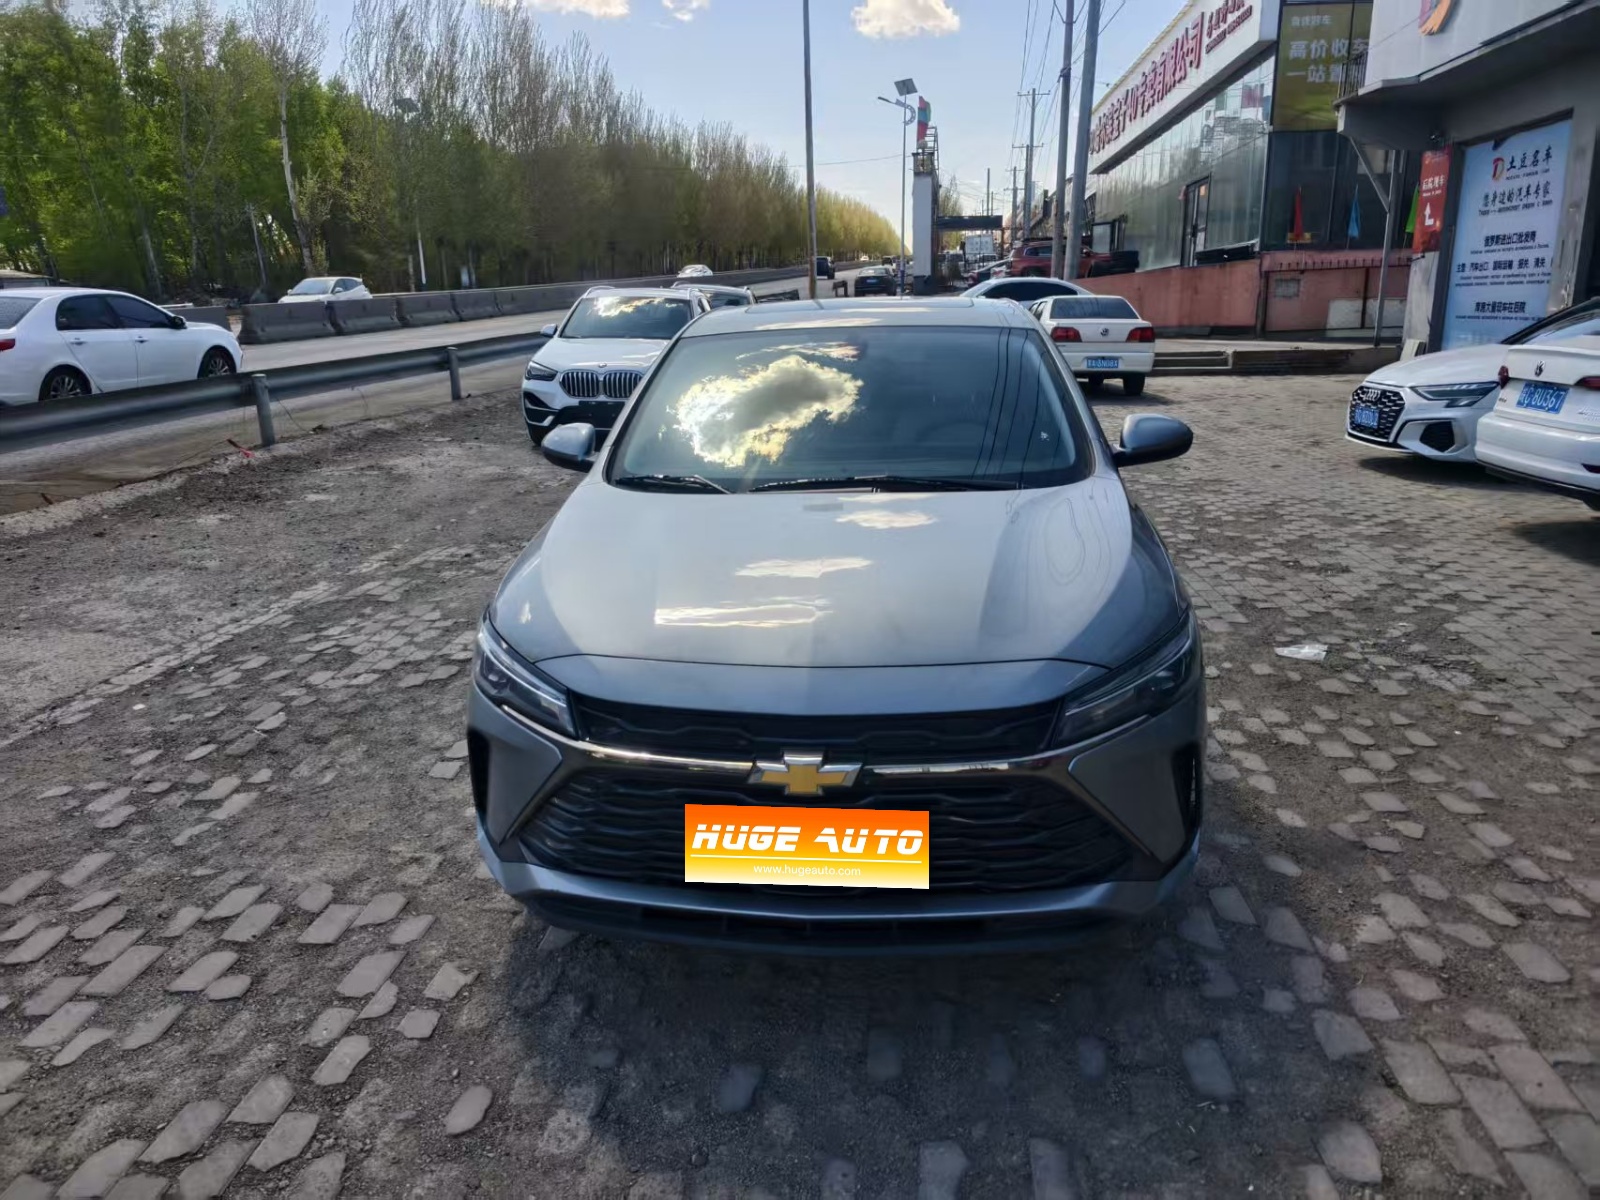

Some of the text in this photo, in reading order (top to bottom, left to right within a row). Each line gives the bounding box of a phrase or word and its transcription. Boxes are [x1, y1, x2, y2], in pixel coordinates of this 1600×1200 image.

[1506, 145, 1552, 172] 土豆名车
[1483, 181, 1550, 207] 您身边的汽车专家
